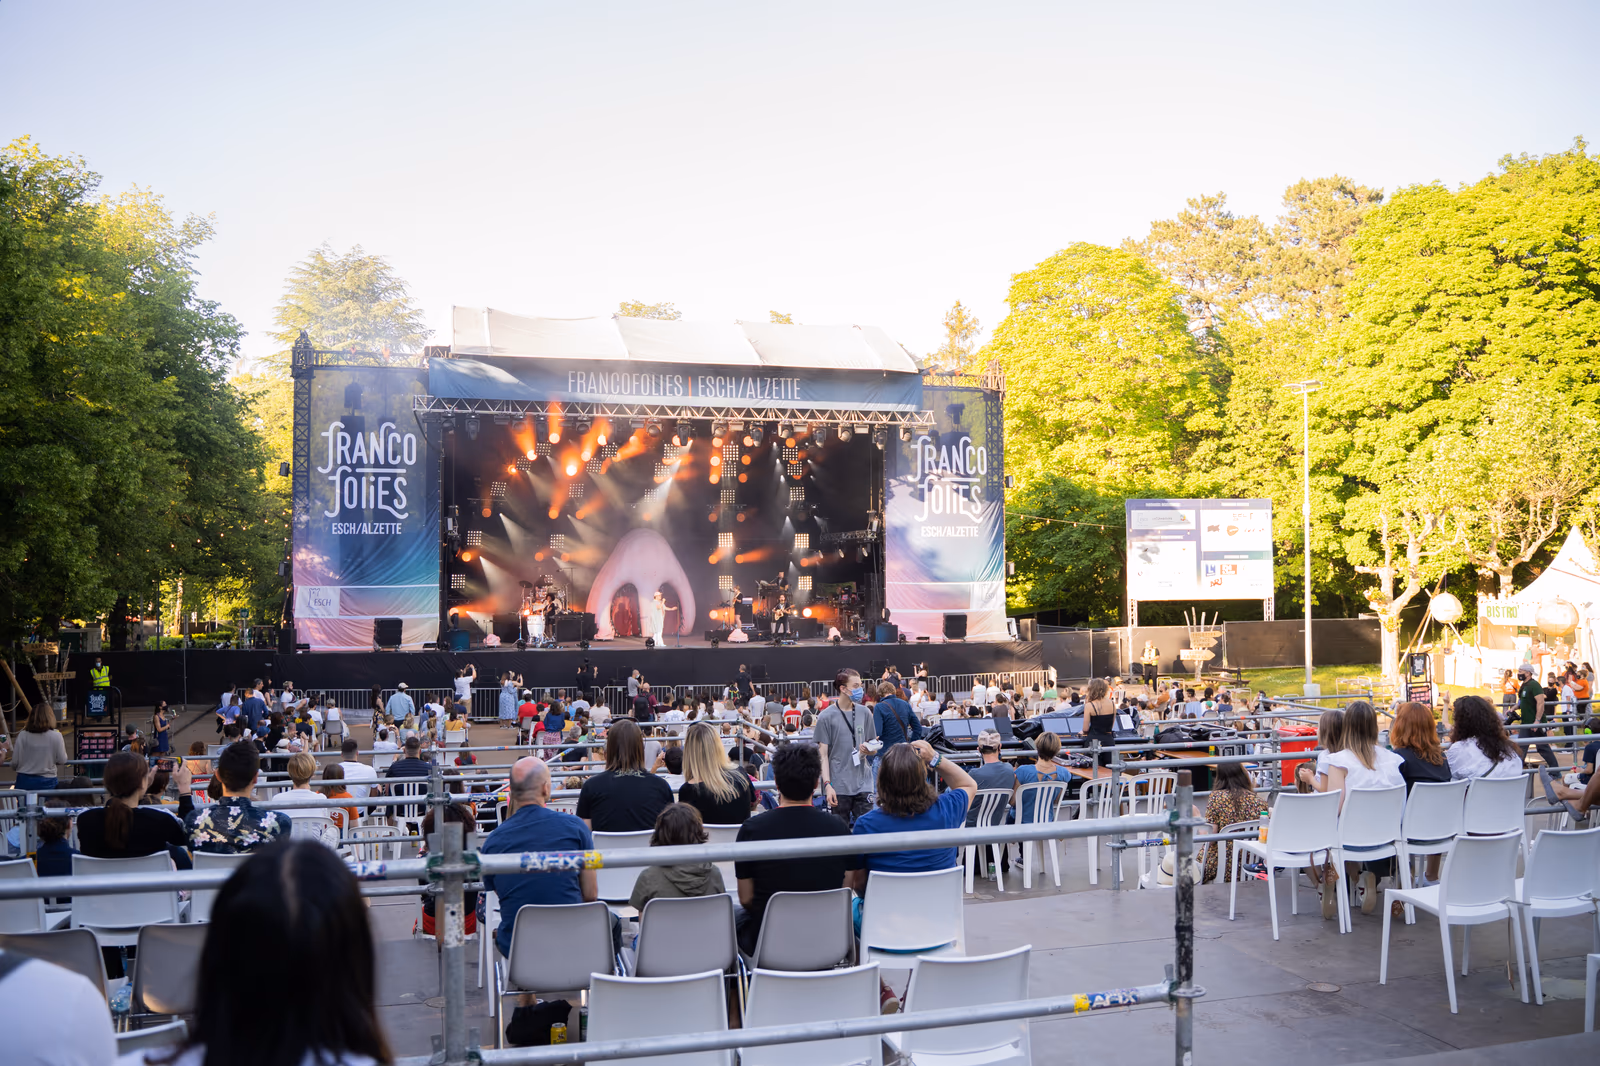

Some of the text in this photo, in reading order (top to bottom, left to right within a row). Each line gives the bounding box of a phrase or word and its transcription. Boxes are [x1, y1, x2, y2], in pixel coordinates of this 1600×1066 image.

[567, 370, 801, 401] FRANCOFOLIES ESCH/ALZETTE
[317, 421, 417, 474] FRANCO
[331, 522, 402, 535] ESCH/ALZETTE
[920, 525, 979, 538] ESCH/ALZETTE
